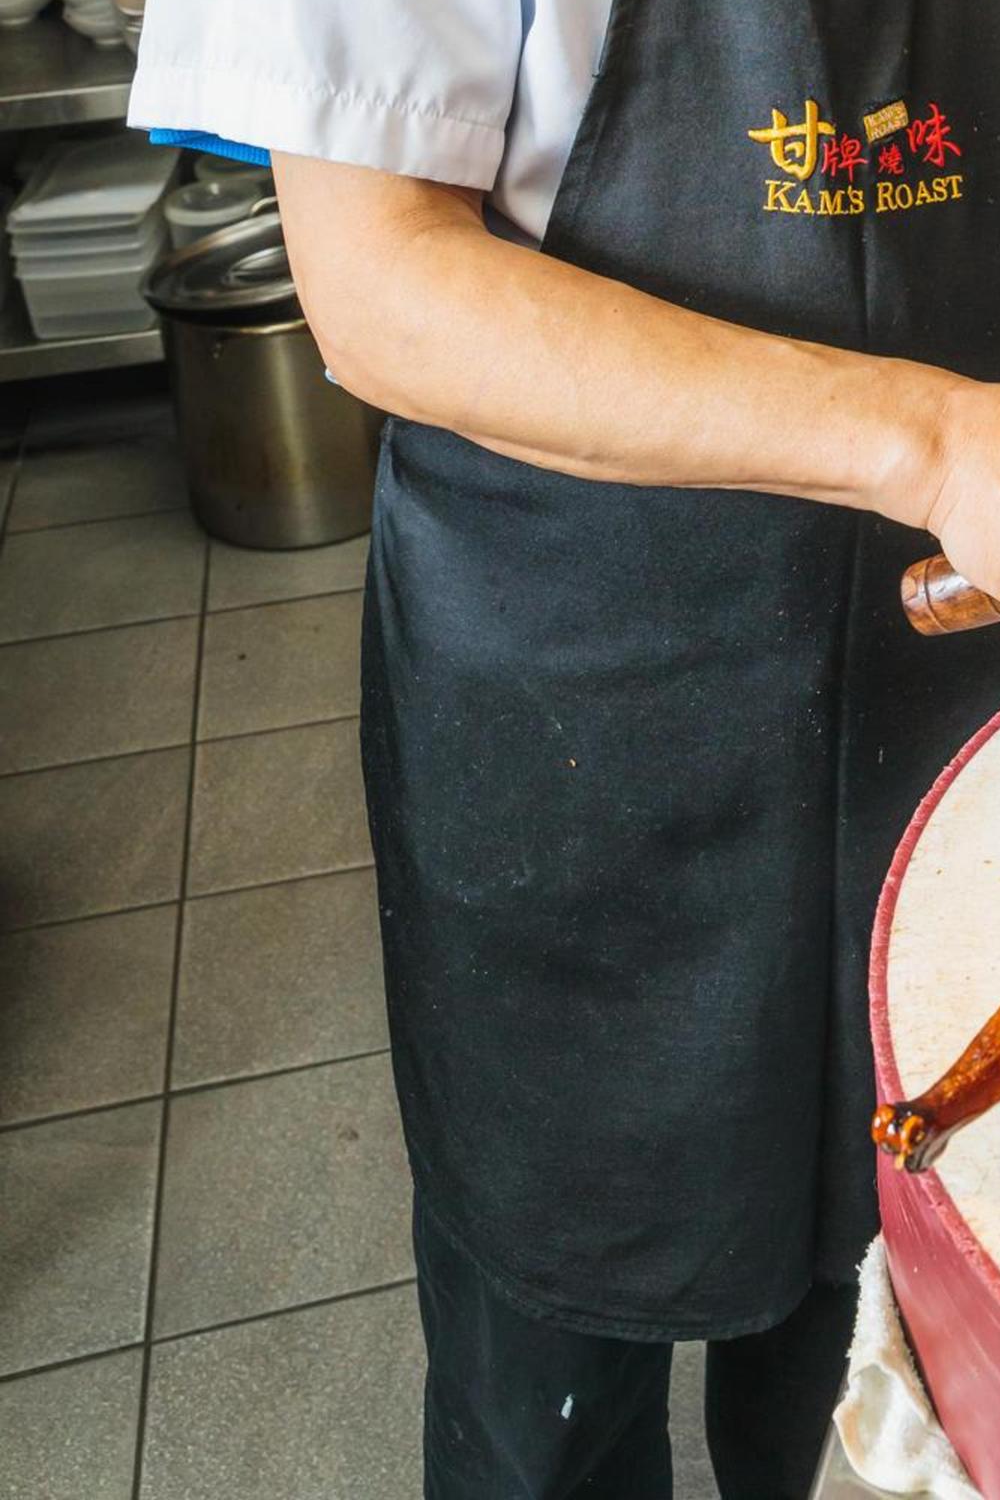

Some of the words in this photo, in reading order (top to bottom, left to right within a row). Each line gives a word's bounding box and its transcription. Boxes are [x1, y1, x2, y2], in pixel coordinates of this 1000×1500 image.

[748, 99, 961, 182] 甘牌燒味
[763, 179, 865, 216] KAM'S
[876, 175, 964, 213] ROAST
